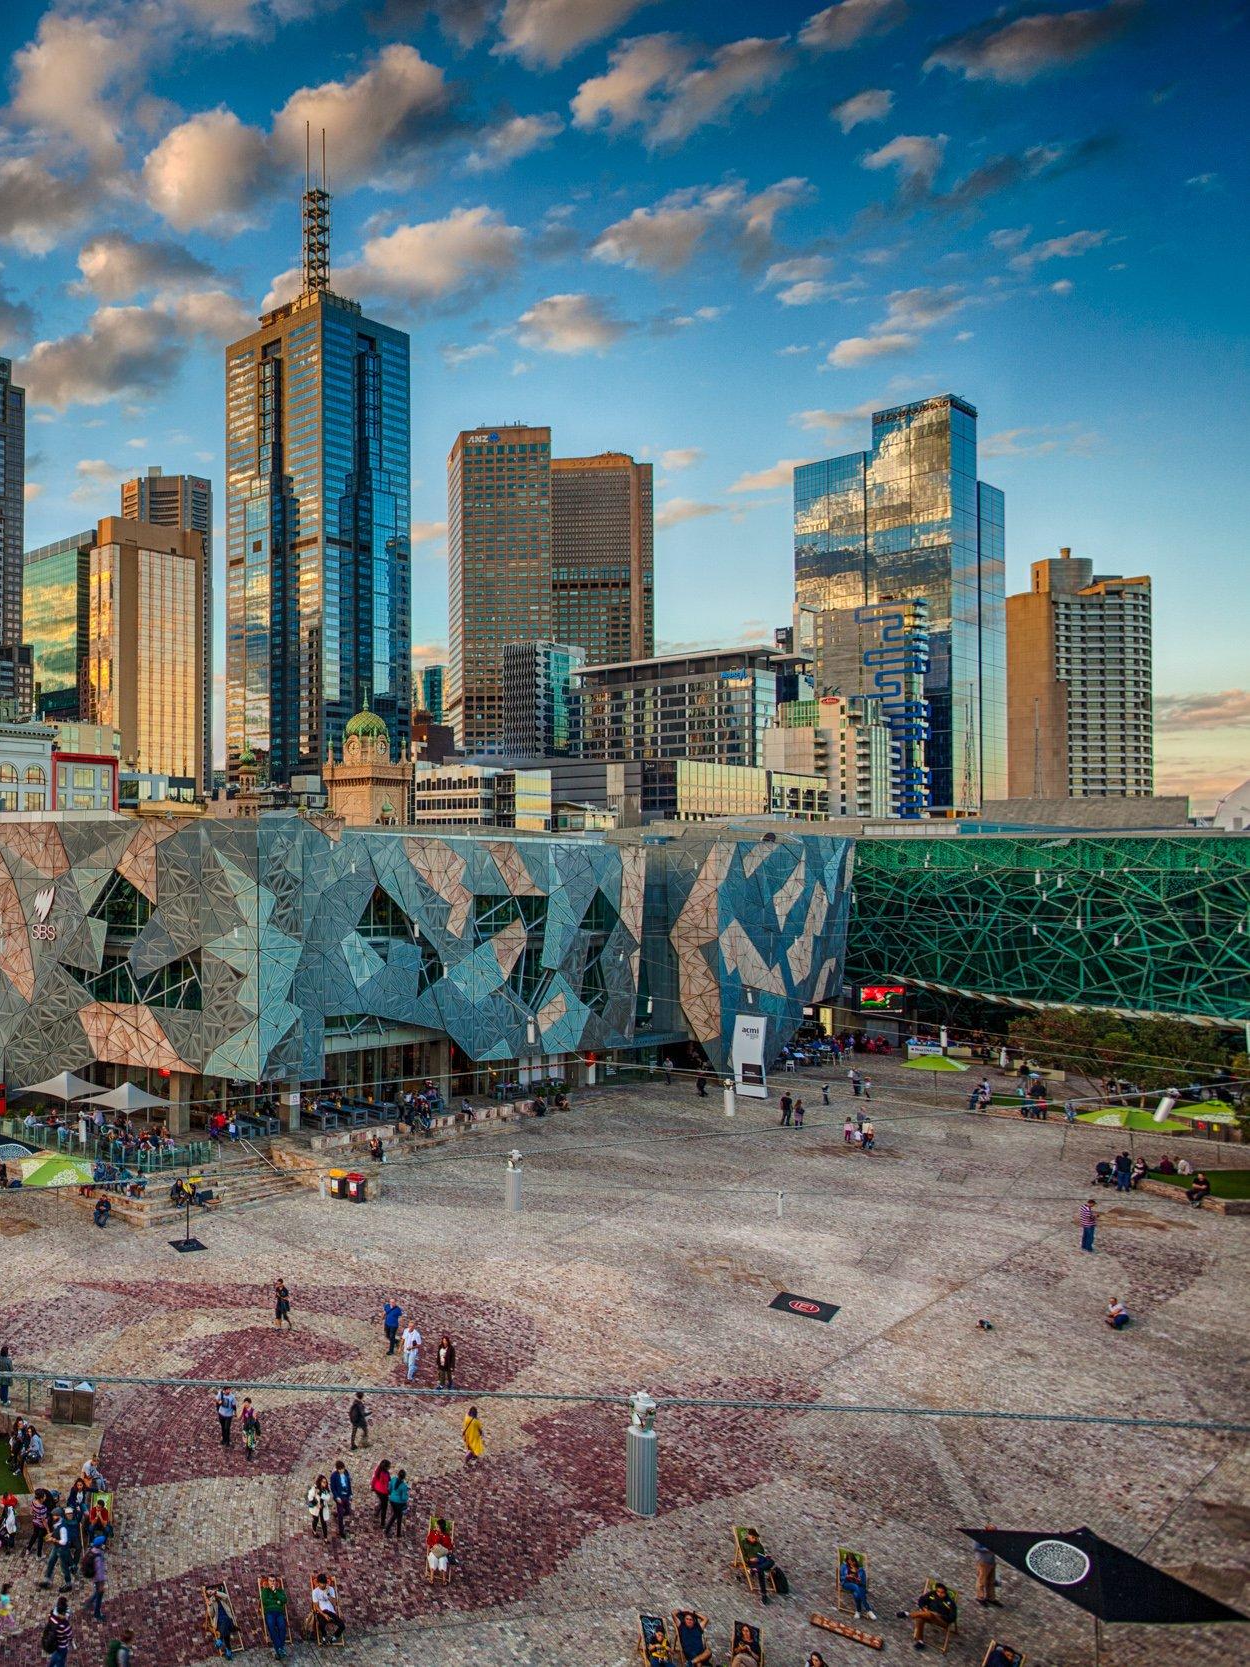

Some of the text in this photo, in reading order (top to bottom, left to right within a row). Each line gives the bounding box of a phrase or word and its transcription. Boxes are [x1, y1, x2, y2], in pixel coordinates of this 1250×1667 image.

[467, 435, 489, 444] ANZ
[32, 924, 56, 940] SBS
[742, 1026, 760, 1034] acmi
